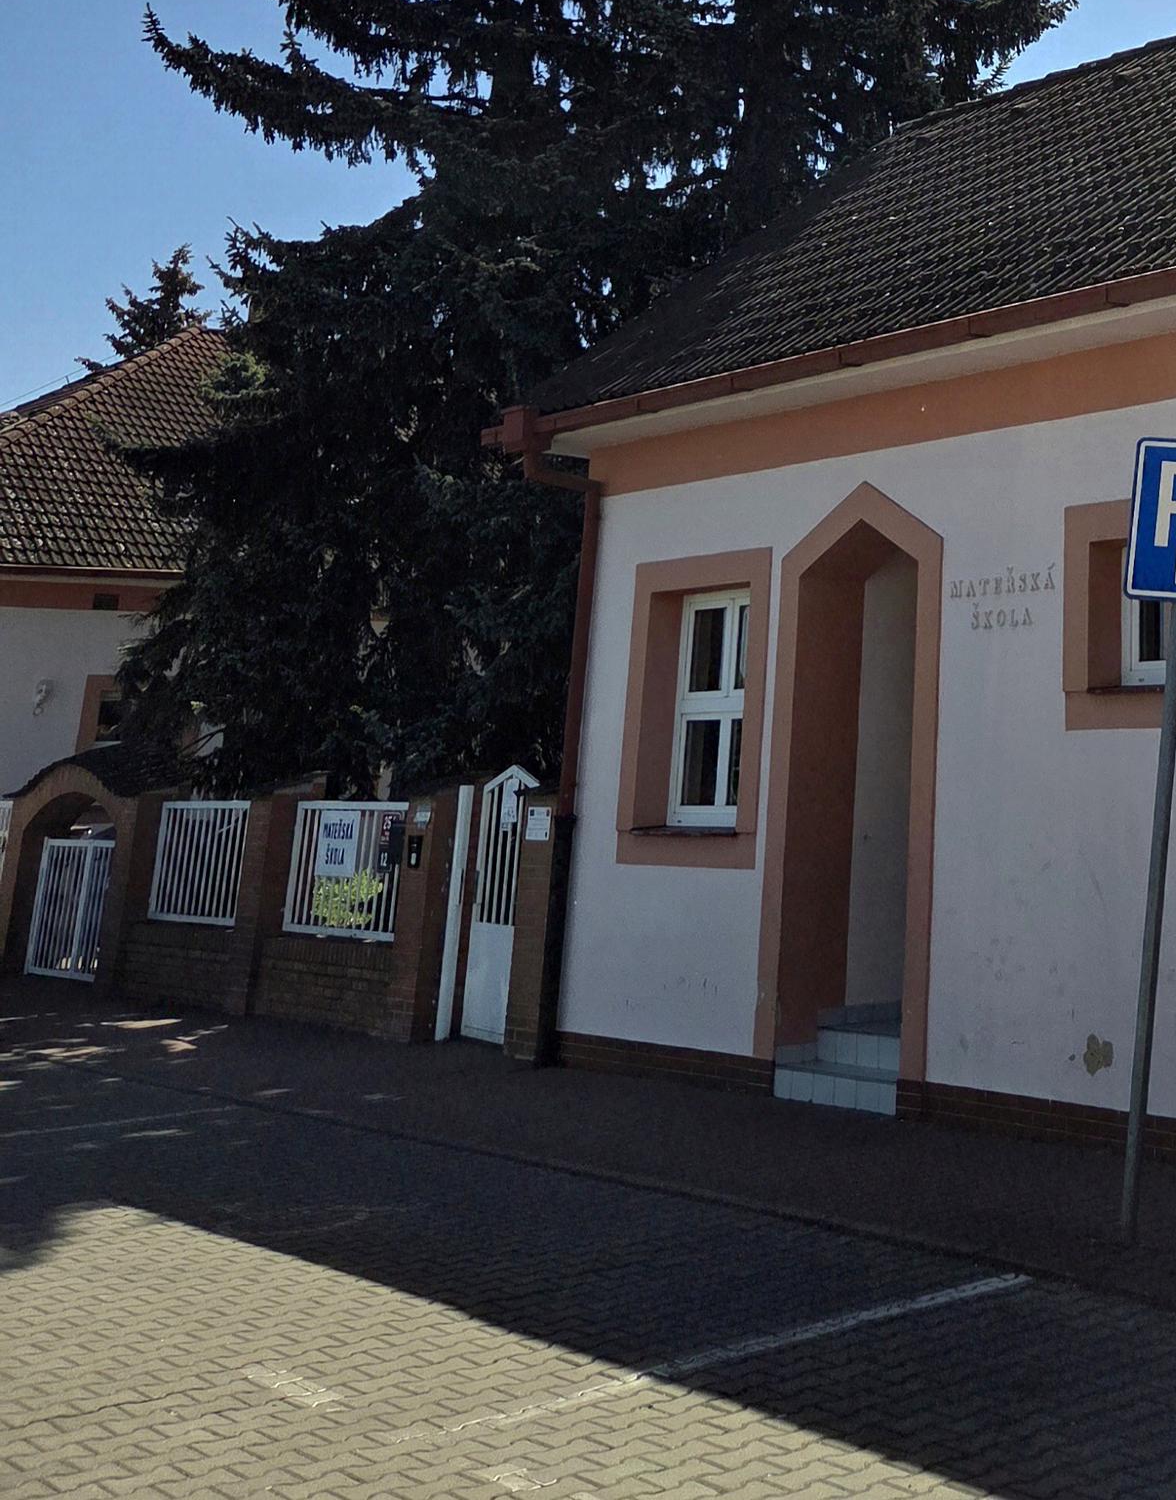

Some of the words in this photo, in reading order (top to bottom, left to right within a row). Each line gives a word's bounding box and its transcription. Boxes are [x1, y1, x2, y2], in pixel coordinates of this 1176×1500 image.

[950, 562, 1056, 598] MATEŘSKÁ
[971, 602, 1033, 630] ŠKOLA
[323, 818, 354, 839] MATEŘSKÁ
[325, 843, 345, 865] ŠKOLA
